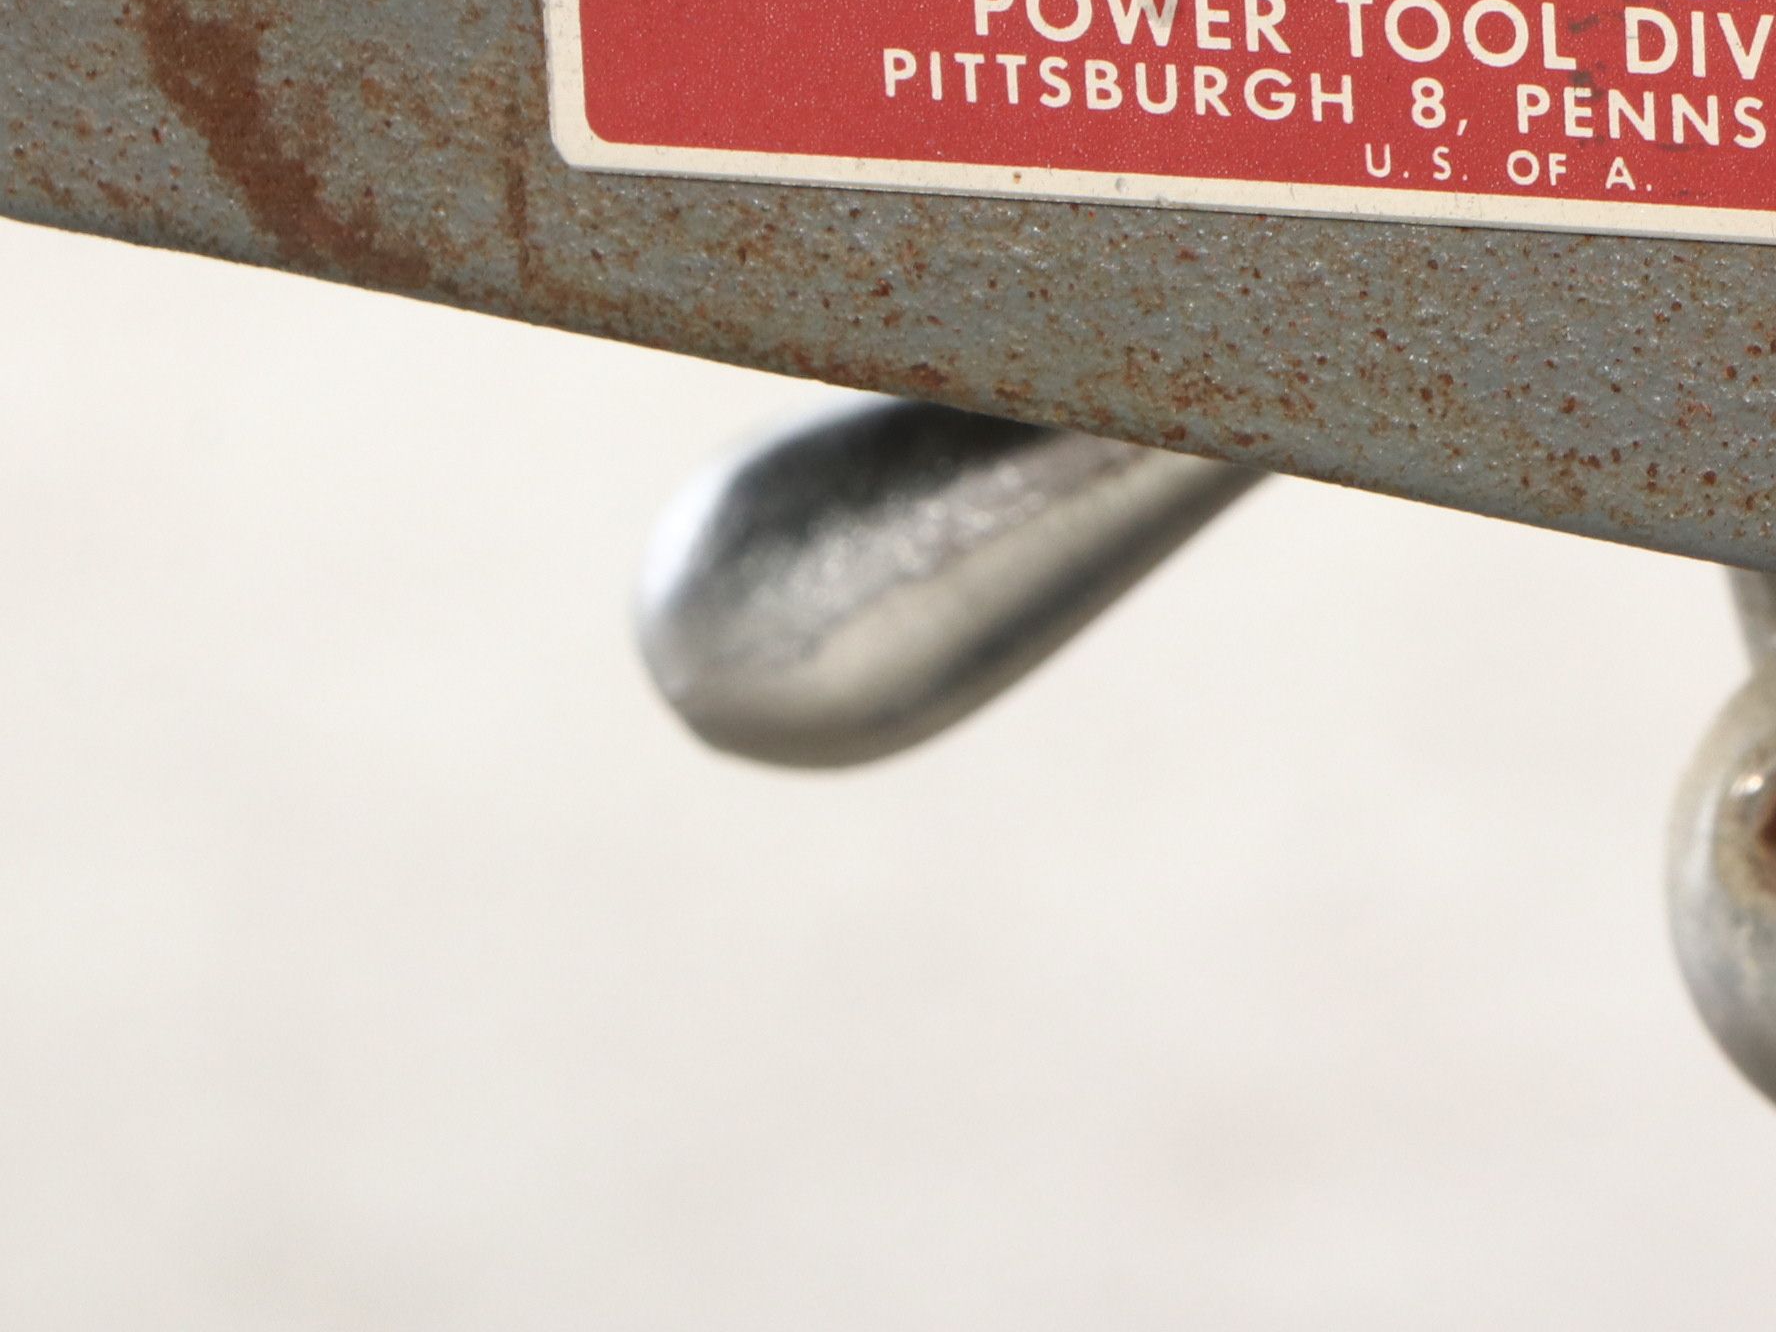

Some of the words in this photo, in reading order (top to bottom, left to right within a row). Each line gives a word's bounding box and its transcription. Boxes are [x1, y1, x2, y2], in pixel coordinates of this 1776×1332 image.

[882, 47, 1355, 125] PITTSBURGH
[1410, 76, 1468, 137] 8,
[1364, 142, 1410, 179] U.
[1432, 145, 1468, 181] S.
[1506, 149, 1568, 187] OF
[1605, 156, 1654, 192] A.
